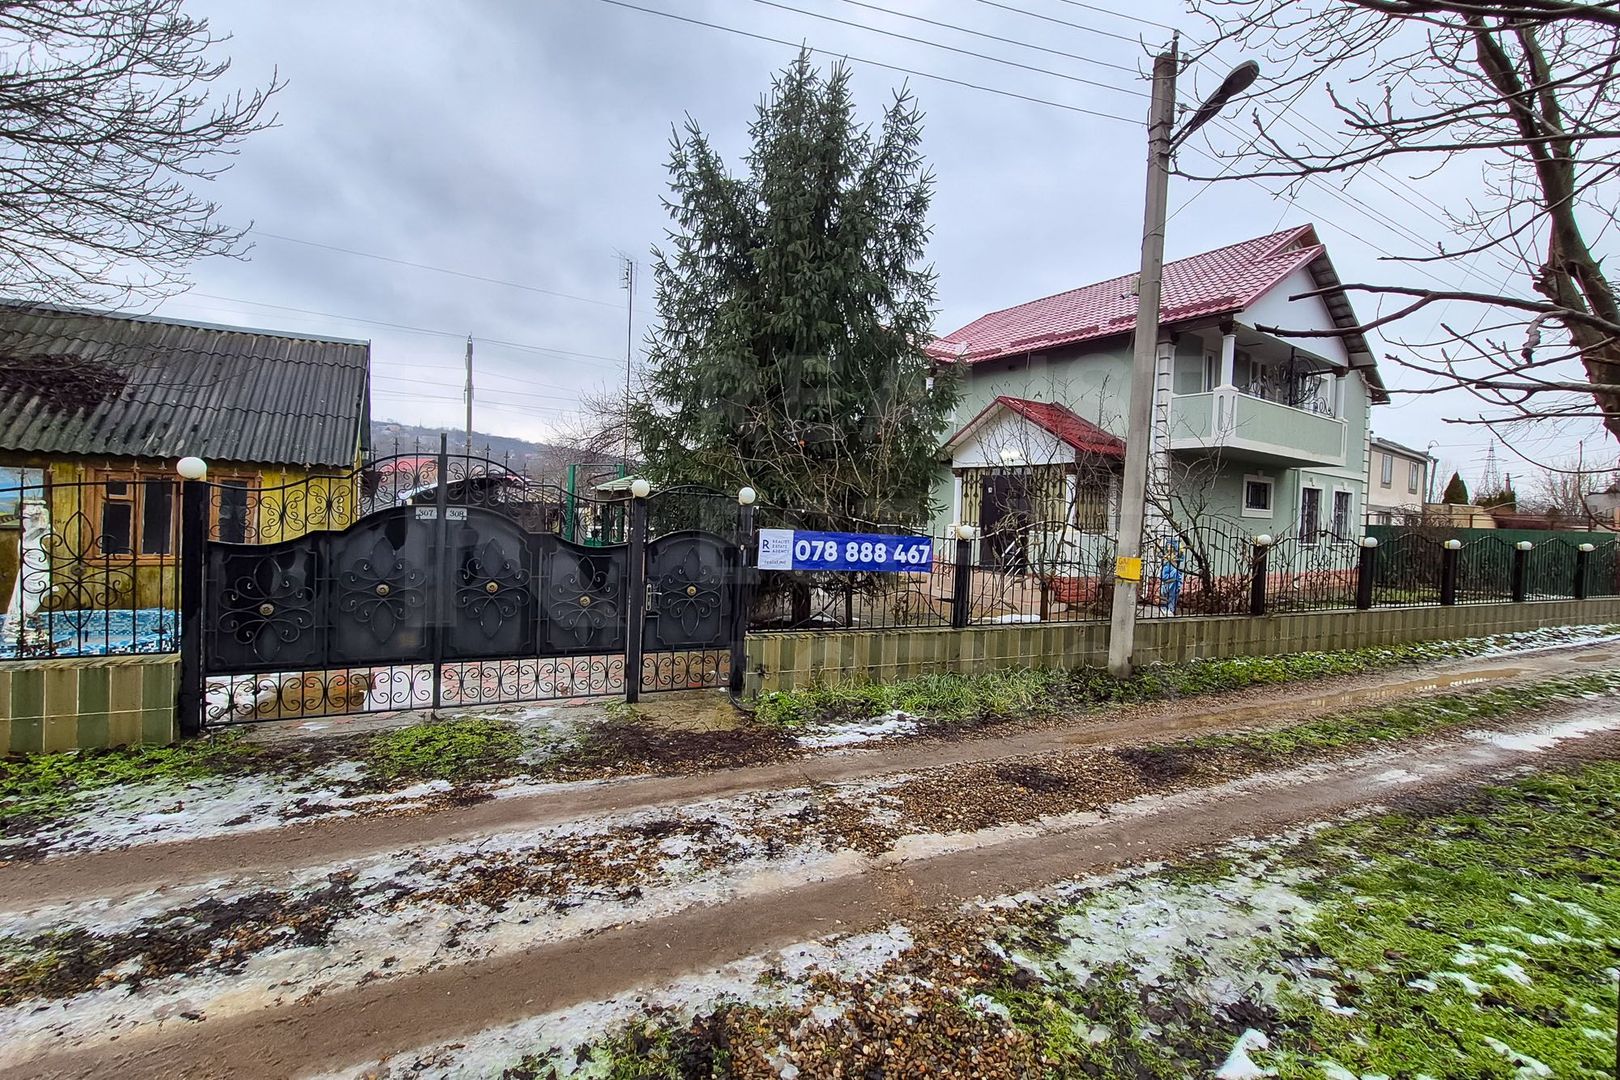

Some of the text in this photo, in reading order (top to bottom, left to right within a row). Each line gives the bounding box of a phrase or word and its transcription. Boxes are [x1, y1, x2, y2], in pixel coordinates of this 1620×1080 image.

[418, 509, 434, 517] 307
[762, 539, 770, 550] R
[795, 540, 930, 564] 078 888 467
